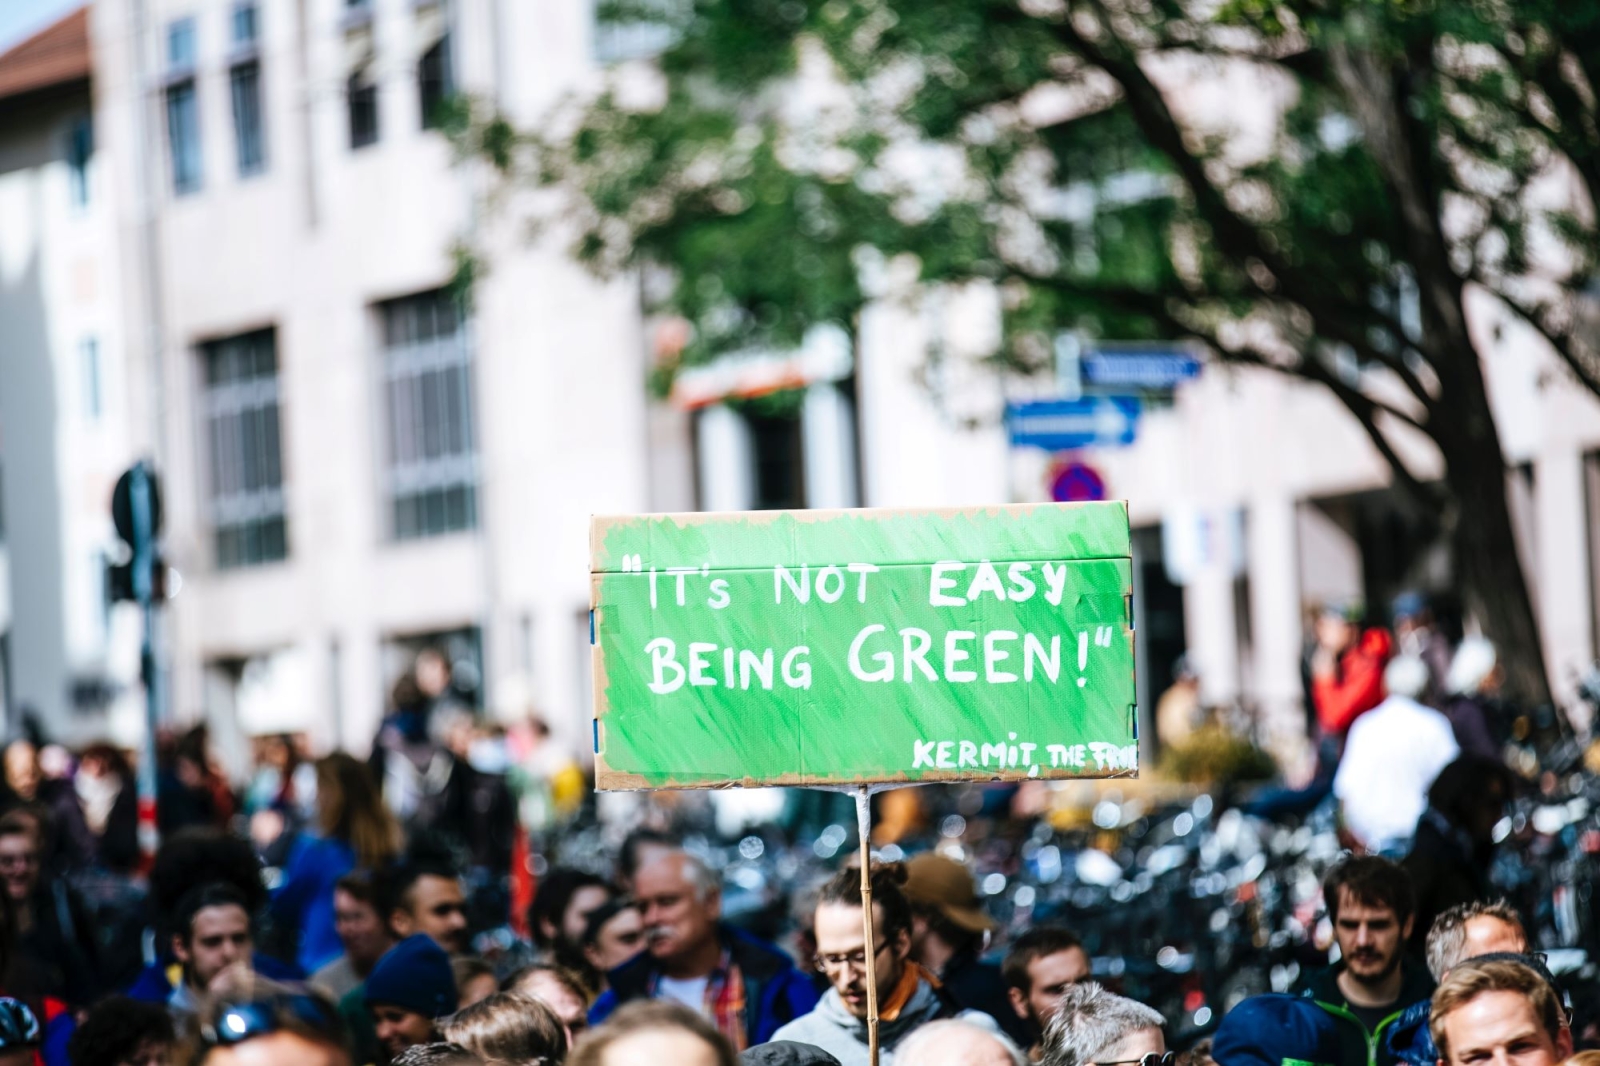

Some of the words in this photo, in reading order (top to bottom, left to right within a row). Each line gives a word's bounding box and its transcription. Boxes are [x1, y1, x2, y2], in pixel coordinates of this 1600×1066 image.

[773, 562, 880, 605] NOT
[929, 559, 1067, 607] EASY
[644, 636, 812, 695] BEING
[847, 624, 1112, 688] GREEN!"
[1046, 744, 1086, 768] THE
